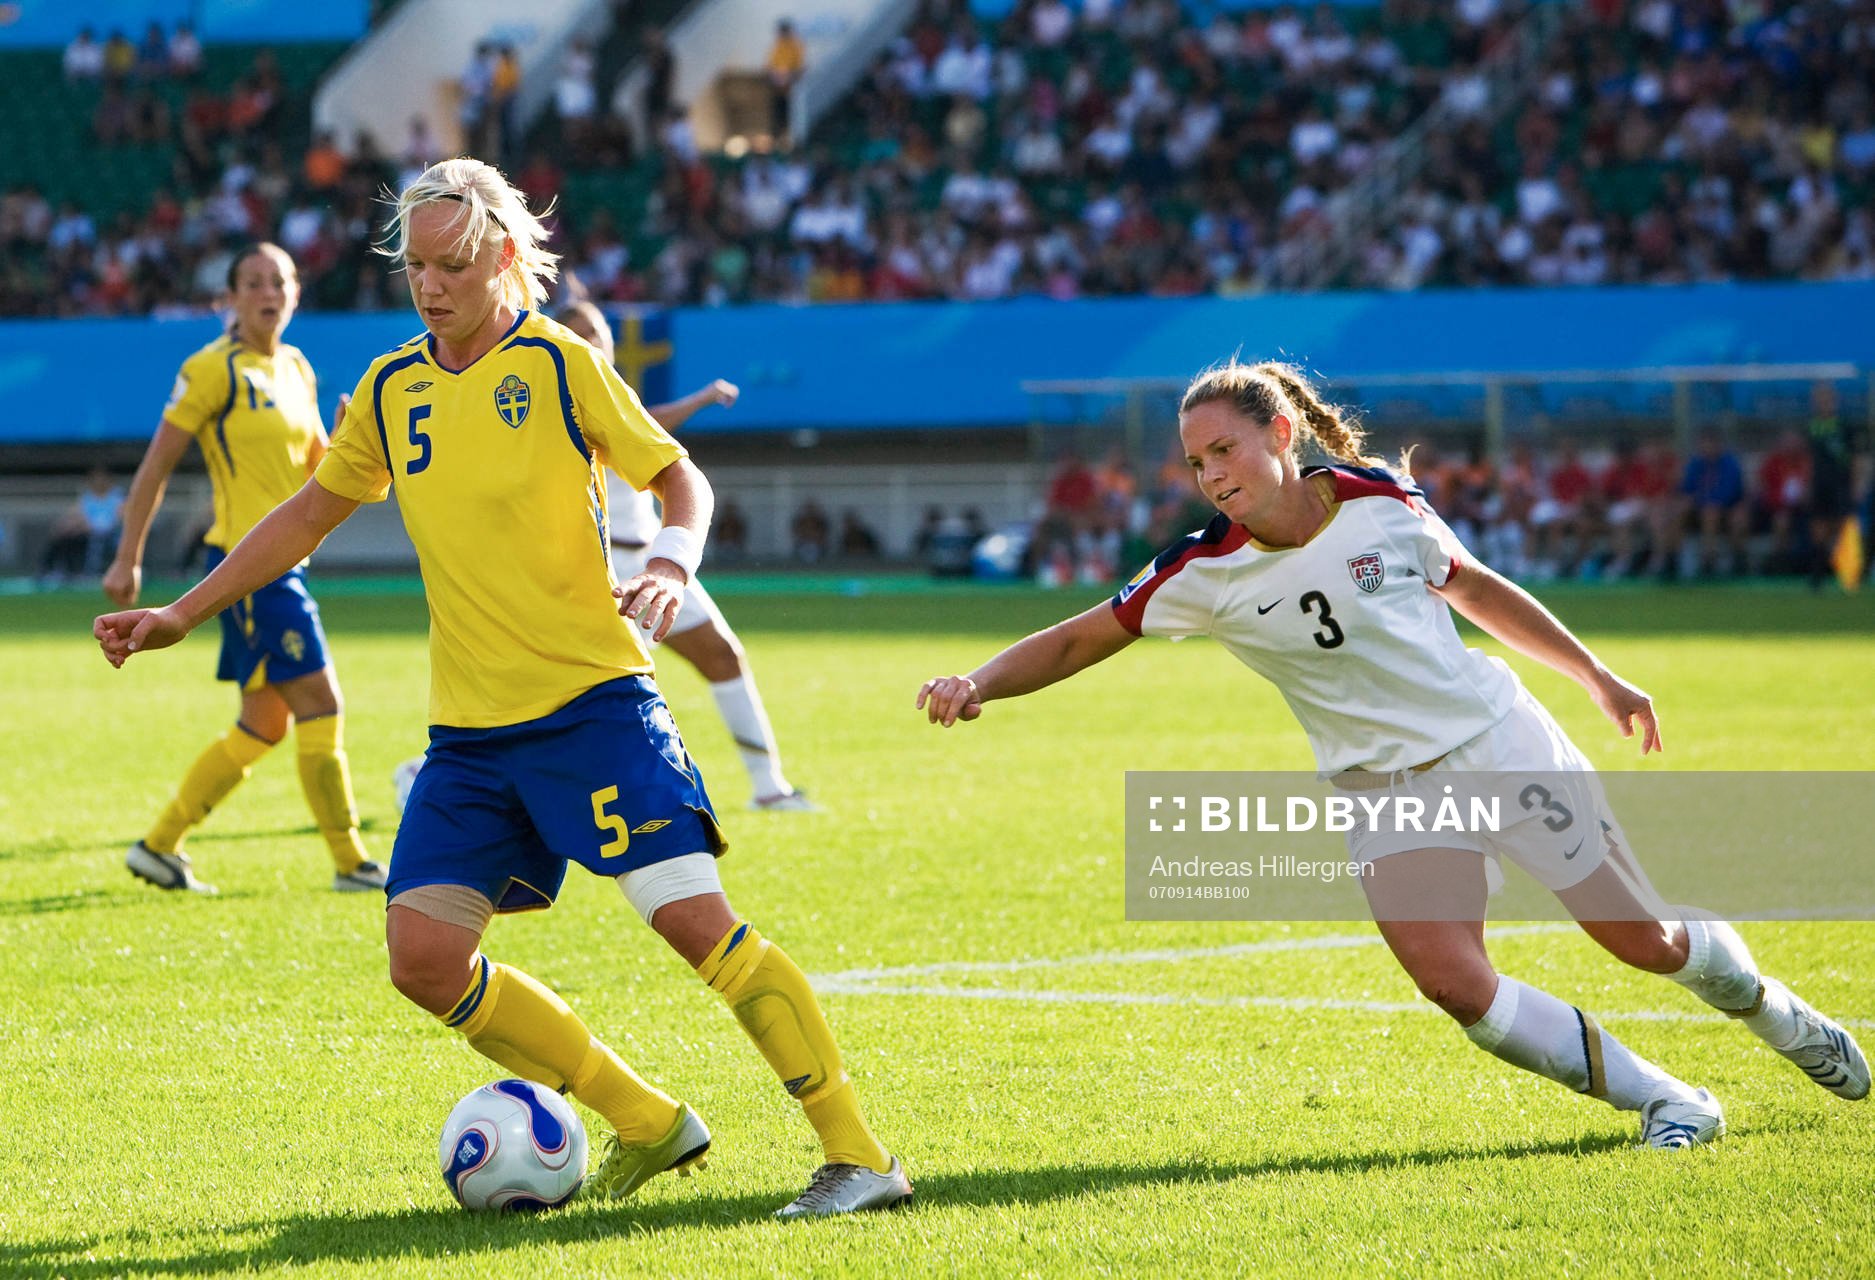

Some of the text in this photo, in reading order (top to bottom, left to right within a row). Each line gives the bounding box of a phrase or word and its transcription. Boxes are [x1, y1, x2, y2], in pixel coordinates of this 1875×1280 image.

[406, 403, 432, 476] 5
[1299, 590, 1345, 650] 3
[591, 784, 630, 859] 5
[1518, 783, 1574, 834] 3
